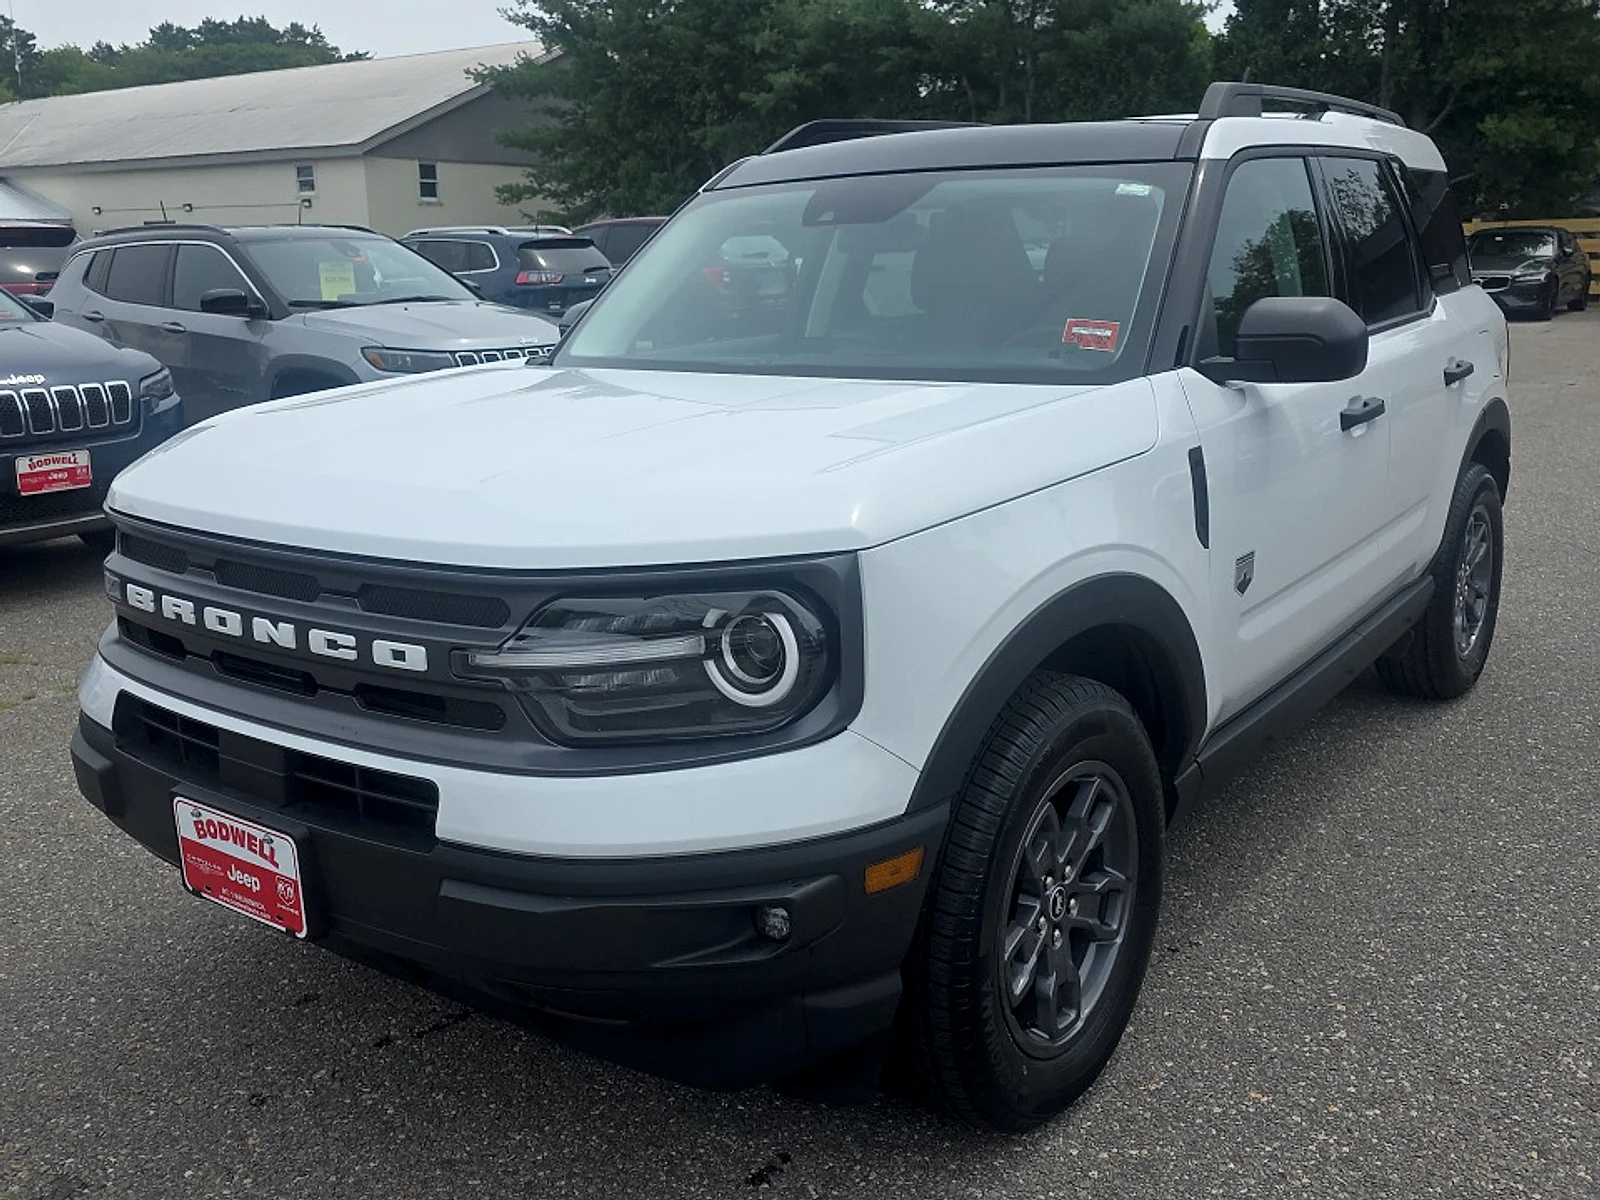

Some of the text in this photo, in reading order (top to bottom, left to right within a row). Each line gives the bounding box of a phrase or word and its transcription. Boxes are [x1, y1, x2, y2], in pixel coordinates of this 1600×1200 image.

[7, 374, 46, 385] Jeep
[28, 456, 79, 471] BODWELL
[126, 583, 428, 672] BRONCO
[193, 819, 280, 869] BODWELL
[226, 863, 261, 893] Jeep
